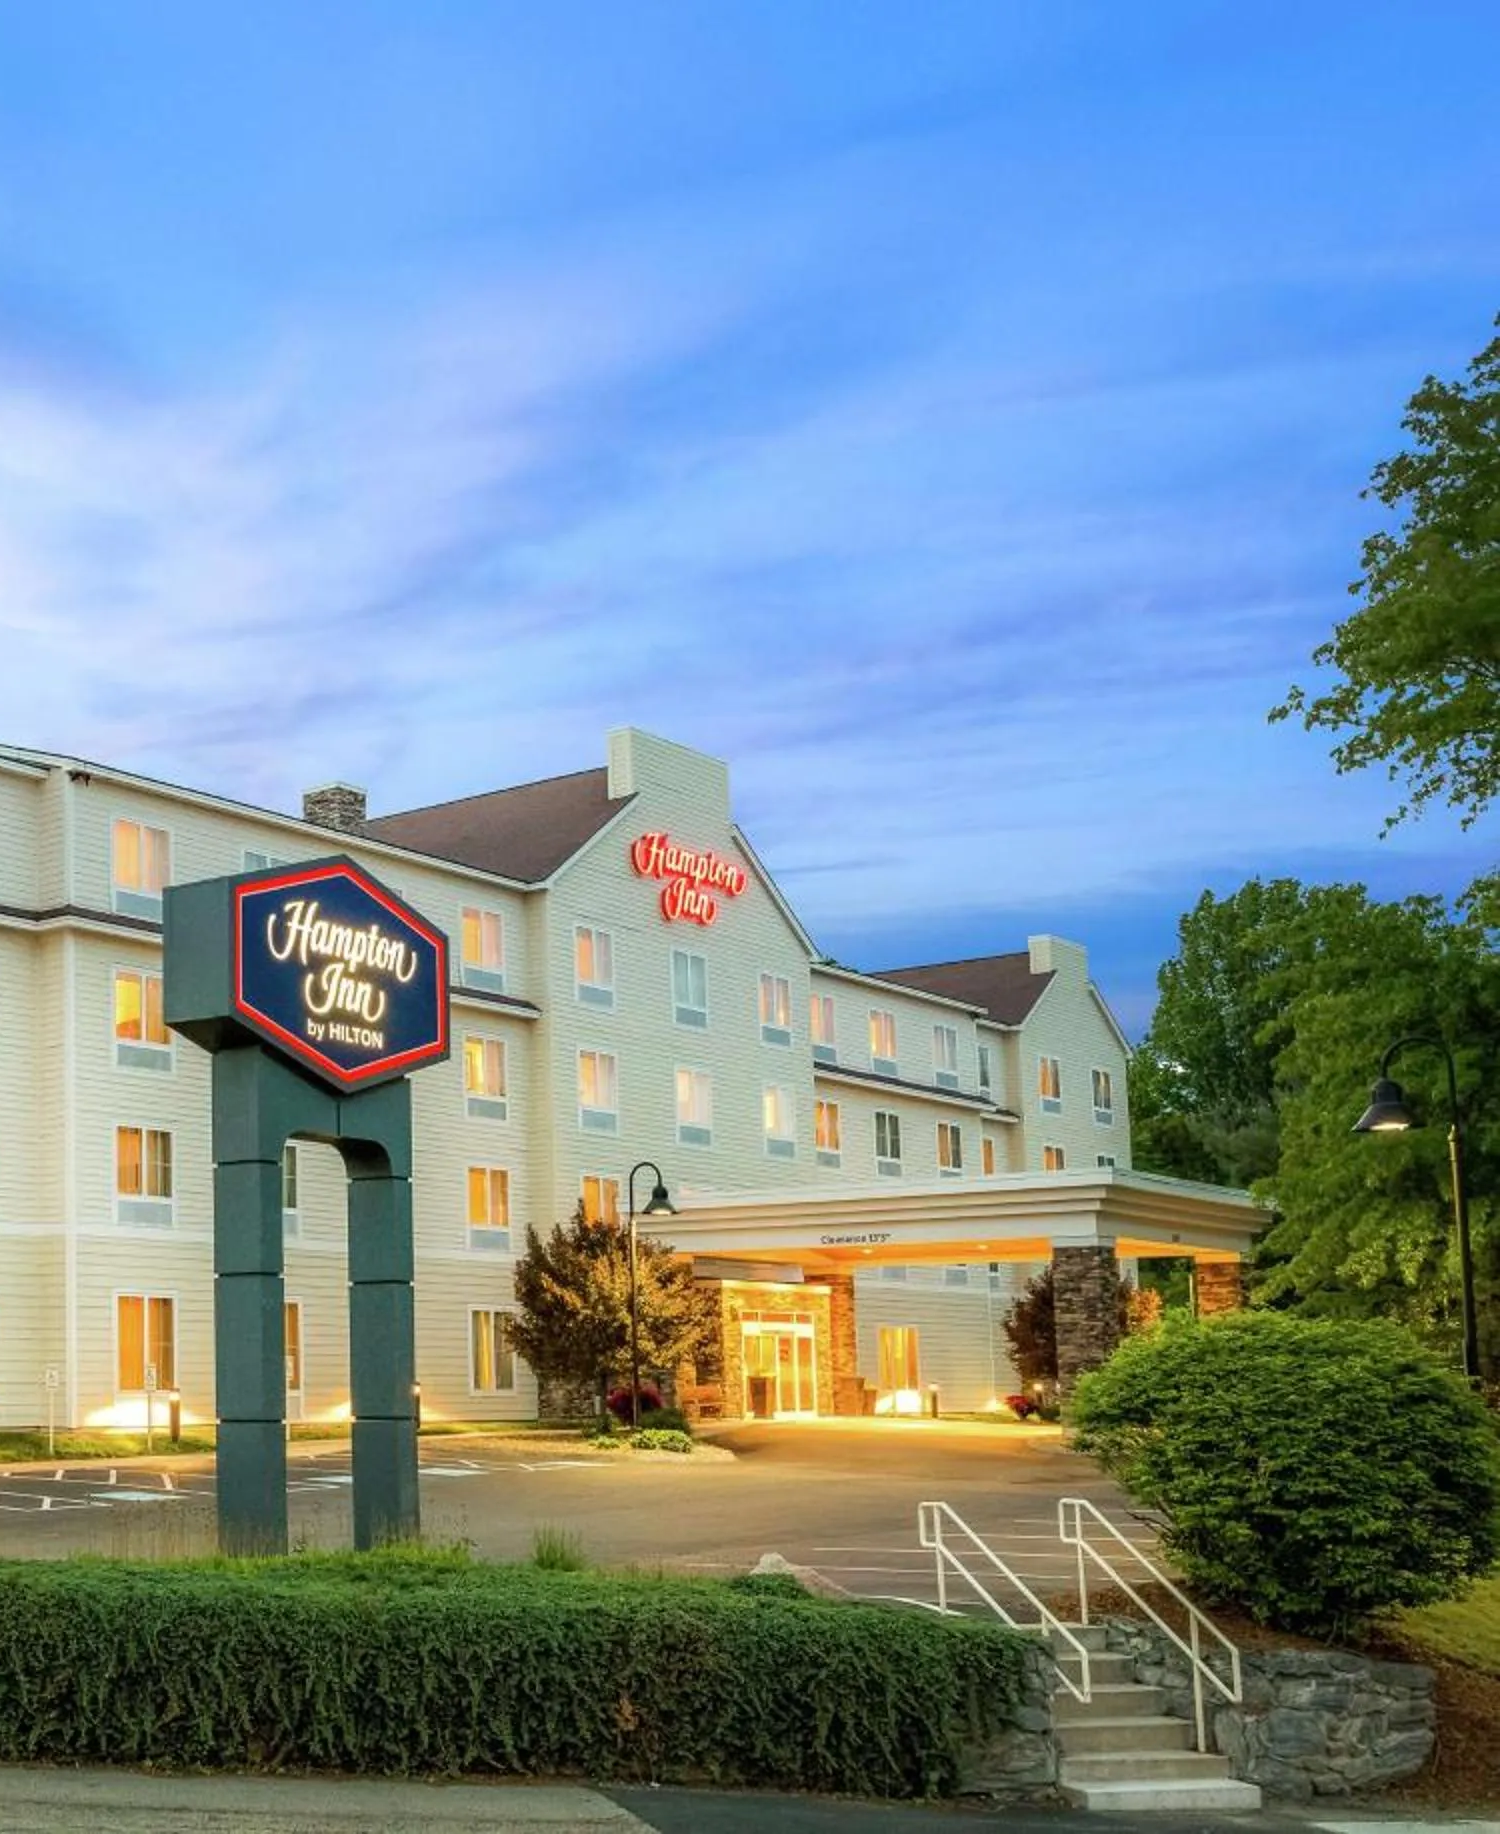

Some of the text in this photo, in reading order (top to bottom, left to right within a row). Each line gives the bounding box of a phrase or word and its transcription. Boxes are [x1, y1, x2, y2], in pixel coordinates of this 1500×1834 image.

[631, 832, 746, 896] Hampton
[661, 877, 716, 925] Inn
[267, 900, 417, 982] Hampton
[305, 963, 384, 1022] Inn
[307, 1018, 383, 1048] by HILTON
